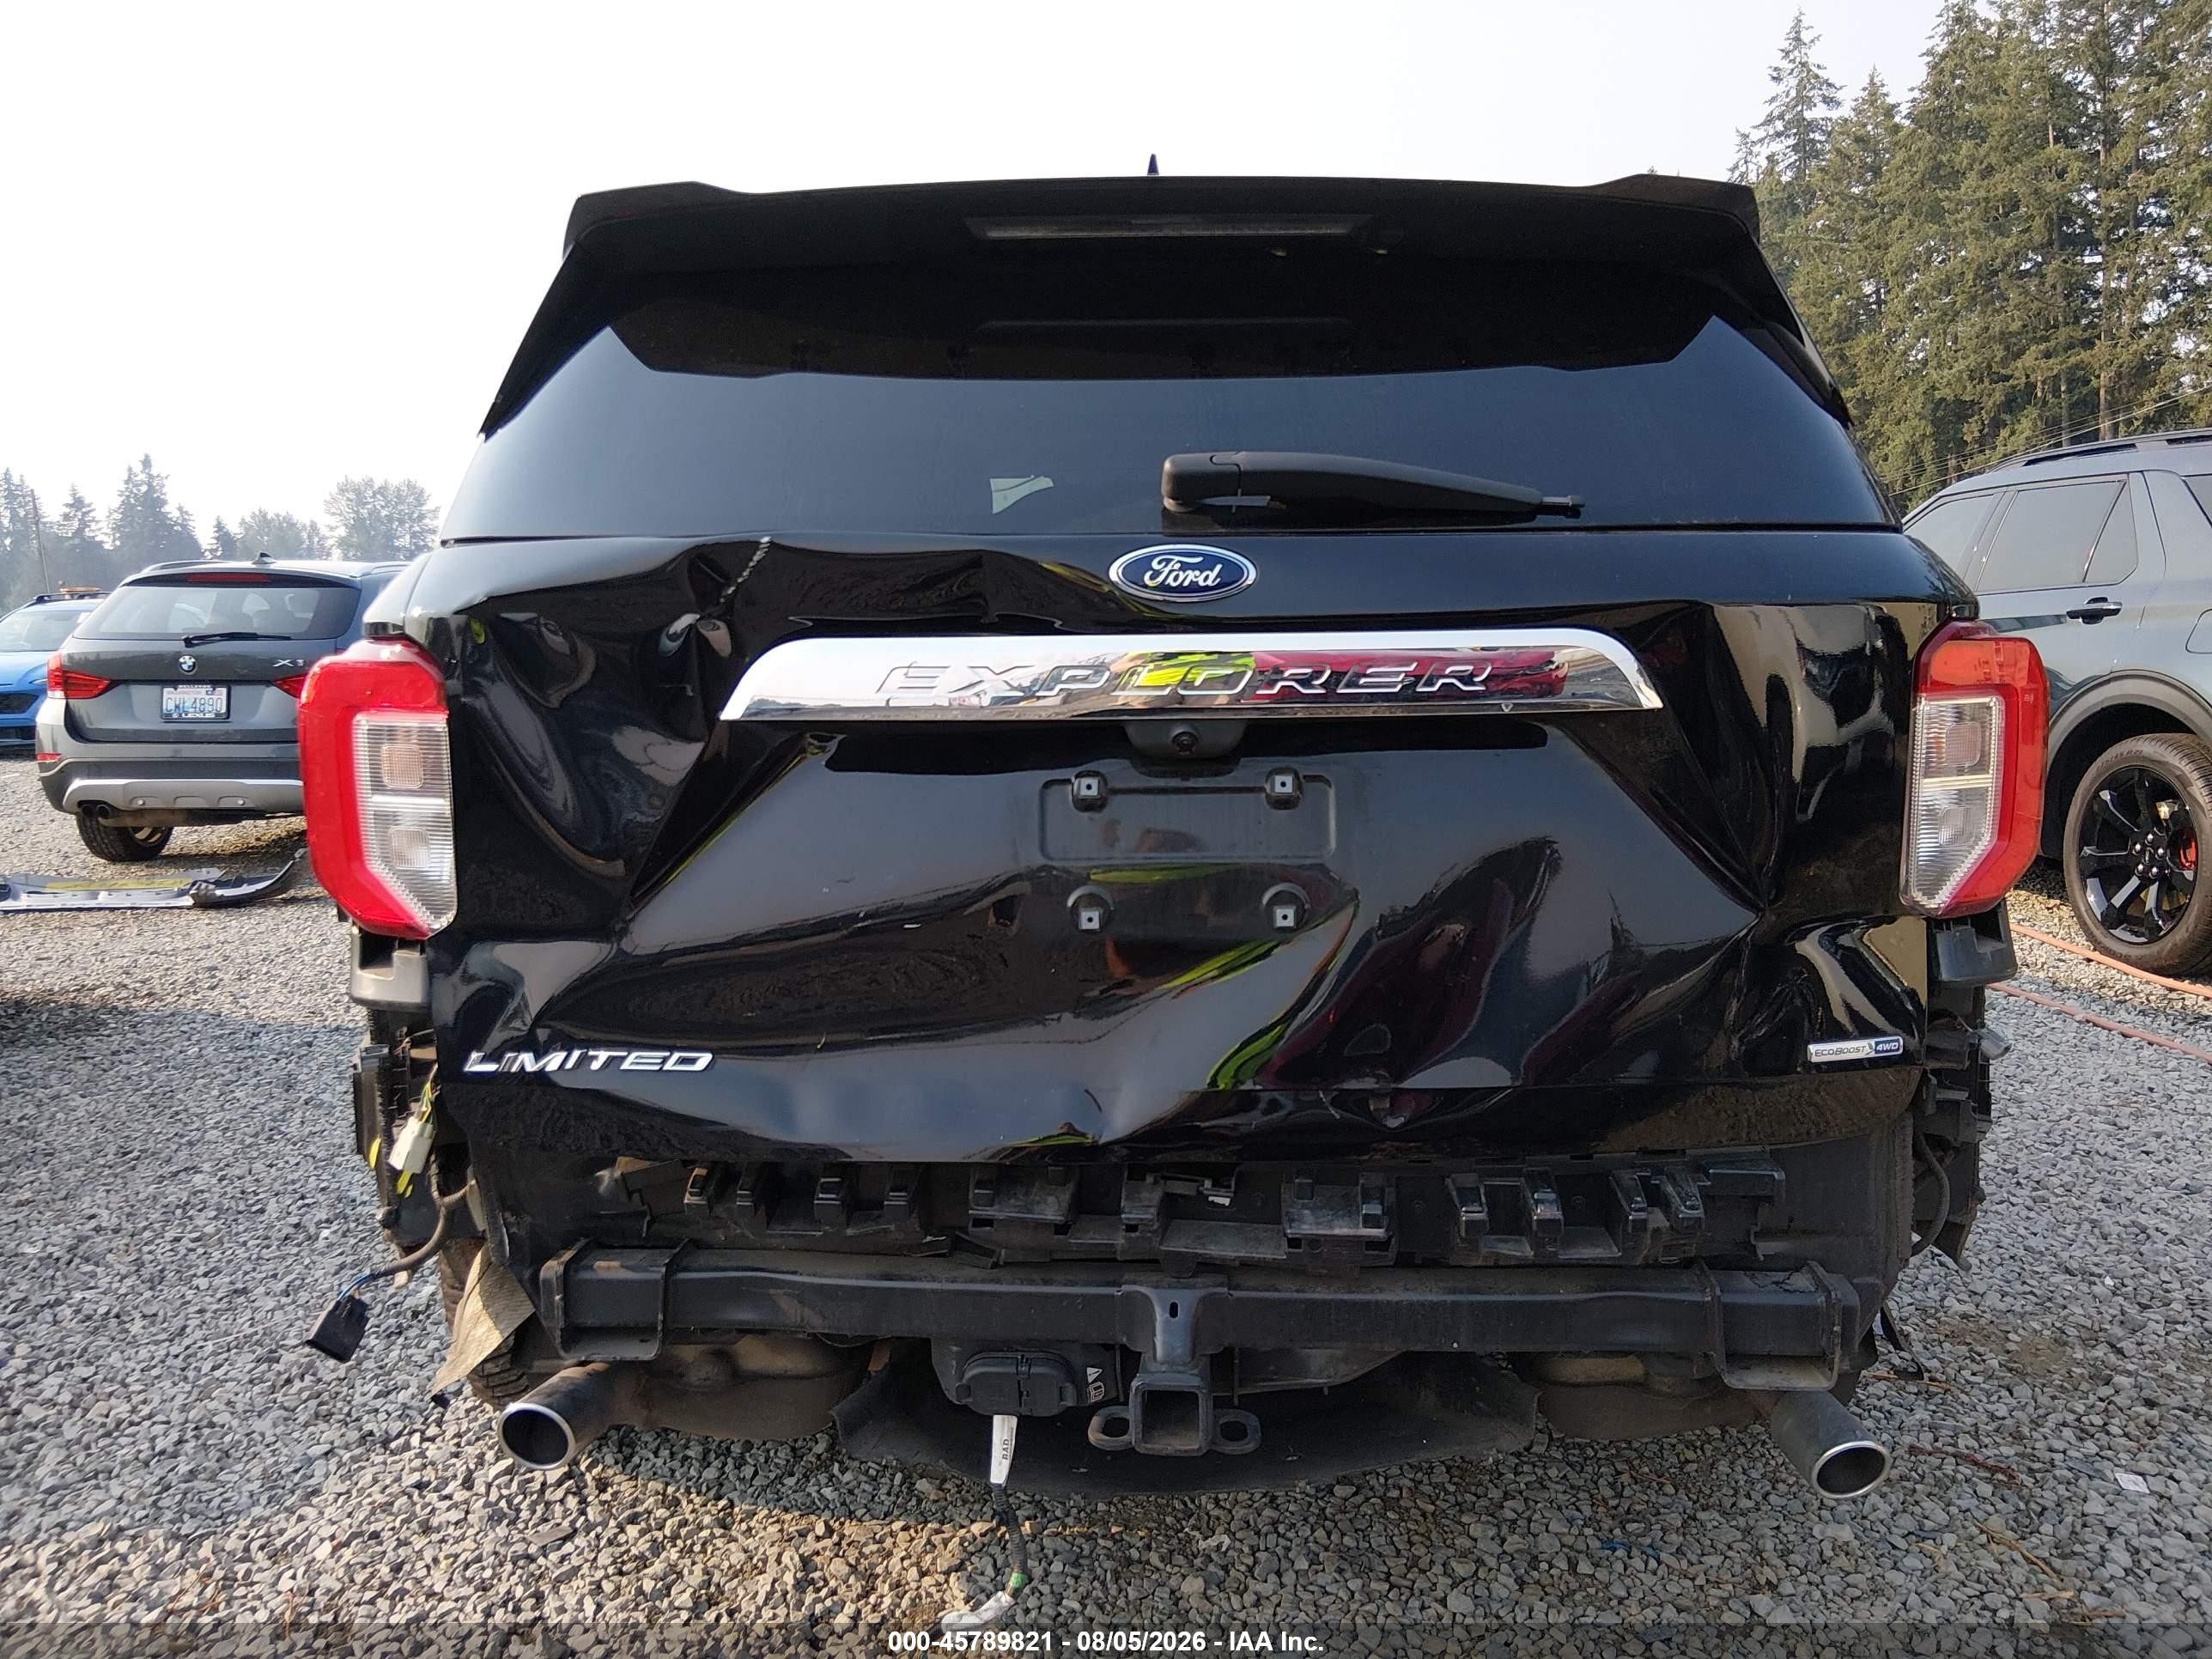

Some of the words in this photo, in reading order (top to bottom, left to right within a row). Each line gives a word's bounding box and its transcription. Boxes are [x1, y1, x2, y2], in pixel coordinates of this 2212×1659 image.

[1144, 555, 1223, 586] Ford
[875, 659, 1492, 706] EXPLORER
[1876, 1042, 1899, 1052] 4WD
[464, 1049, 714, 1073] LIMITED
